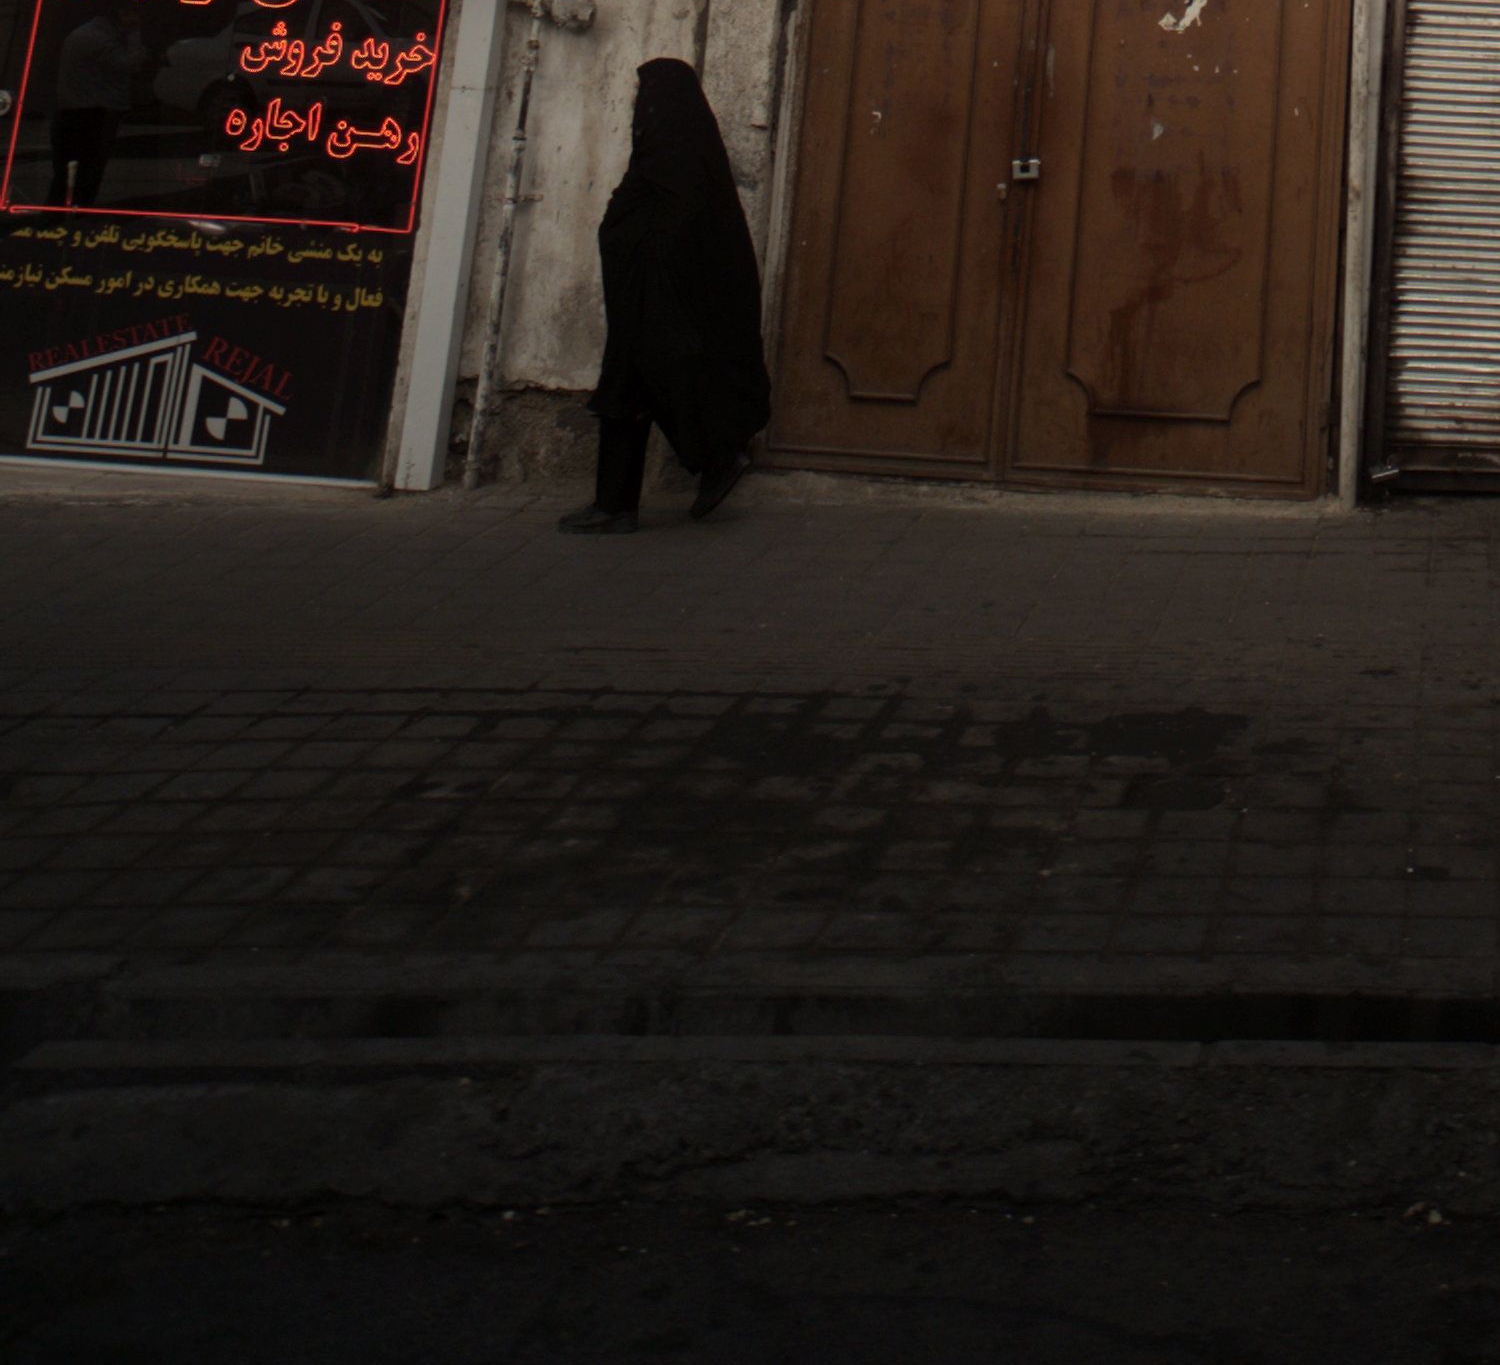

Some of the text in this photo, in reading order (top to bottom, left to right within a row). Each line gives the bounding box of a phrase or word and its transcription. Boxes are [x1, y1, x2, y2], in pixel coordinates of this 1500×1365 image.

[240, 21, 437, 86] خرید فروش
[226, 98, 420, 165] رهن اجاره
[71, 230, 83, 247] و
[205, 237, 245, 258] جهت
[247, 235, 285, 260] خانم
[287, 240, 333, 264] منشی
[336, 244, 363, 266] یک
[367, 247, 384, 268] به
[44, 266, 93, 290] مسکن
[95, 269, 134, 295] امور
[132, 275, 156, 297] در
[156, 274, 222, 300] همکاری
[224, 282, 264, 304] جهت
[331, 293, 342, 312] و
[345, 287, 384, 312] فعال
[201, 335, 296, 401] REJAL
